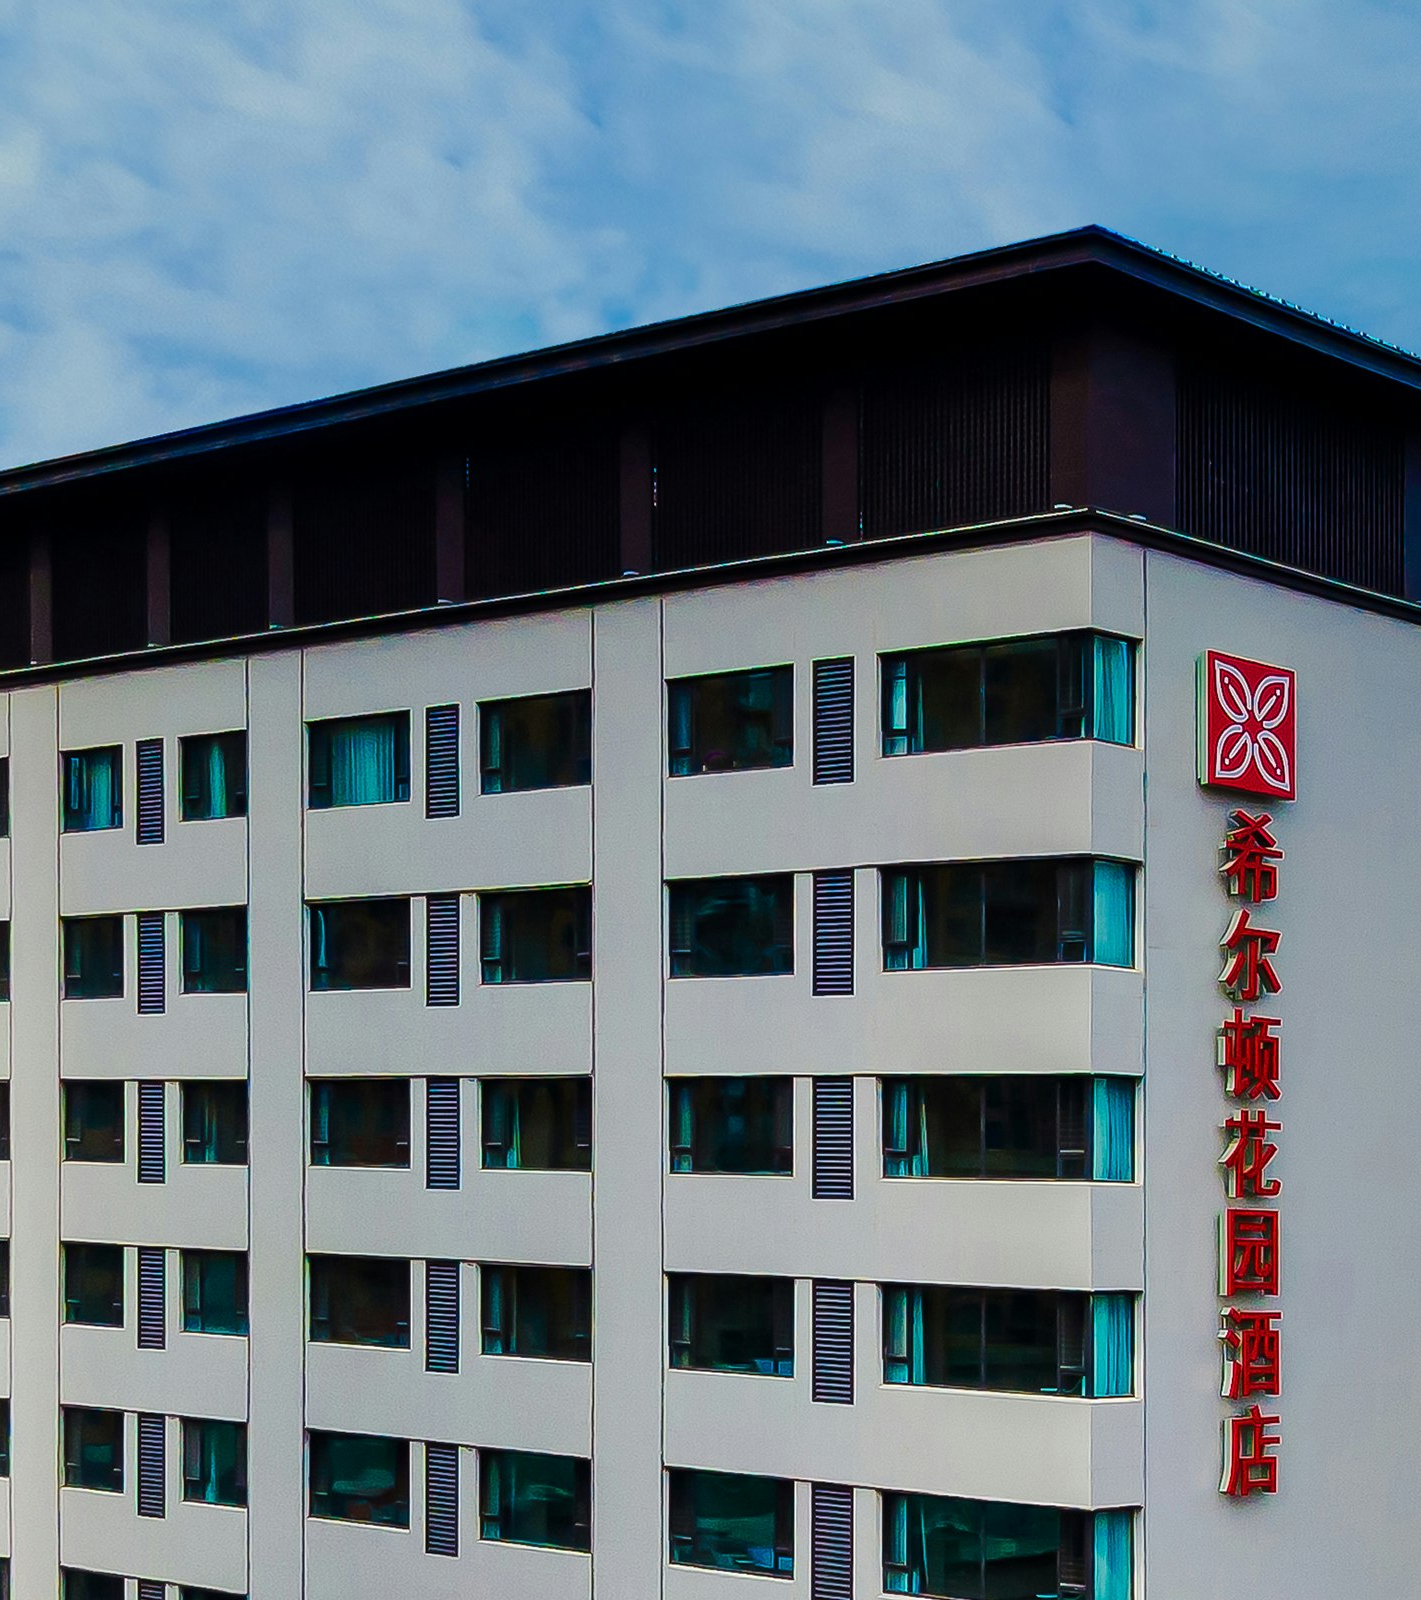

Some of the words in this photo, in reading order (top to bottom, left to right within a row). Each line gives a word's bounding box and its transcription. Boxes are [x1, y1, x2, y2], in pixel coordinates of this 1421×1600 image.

[1217, 808, 1284, 1498] 希尔顿花园酒店
